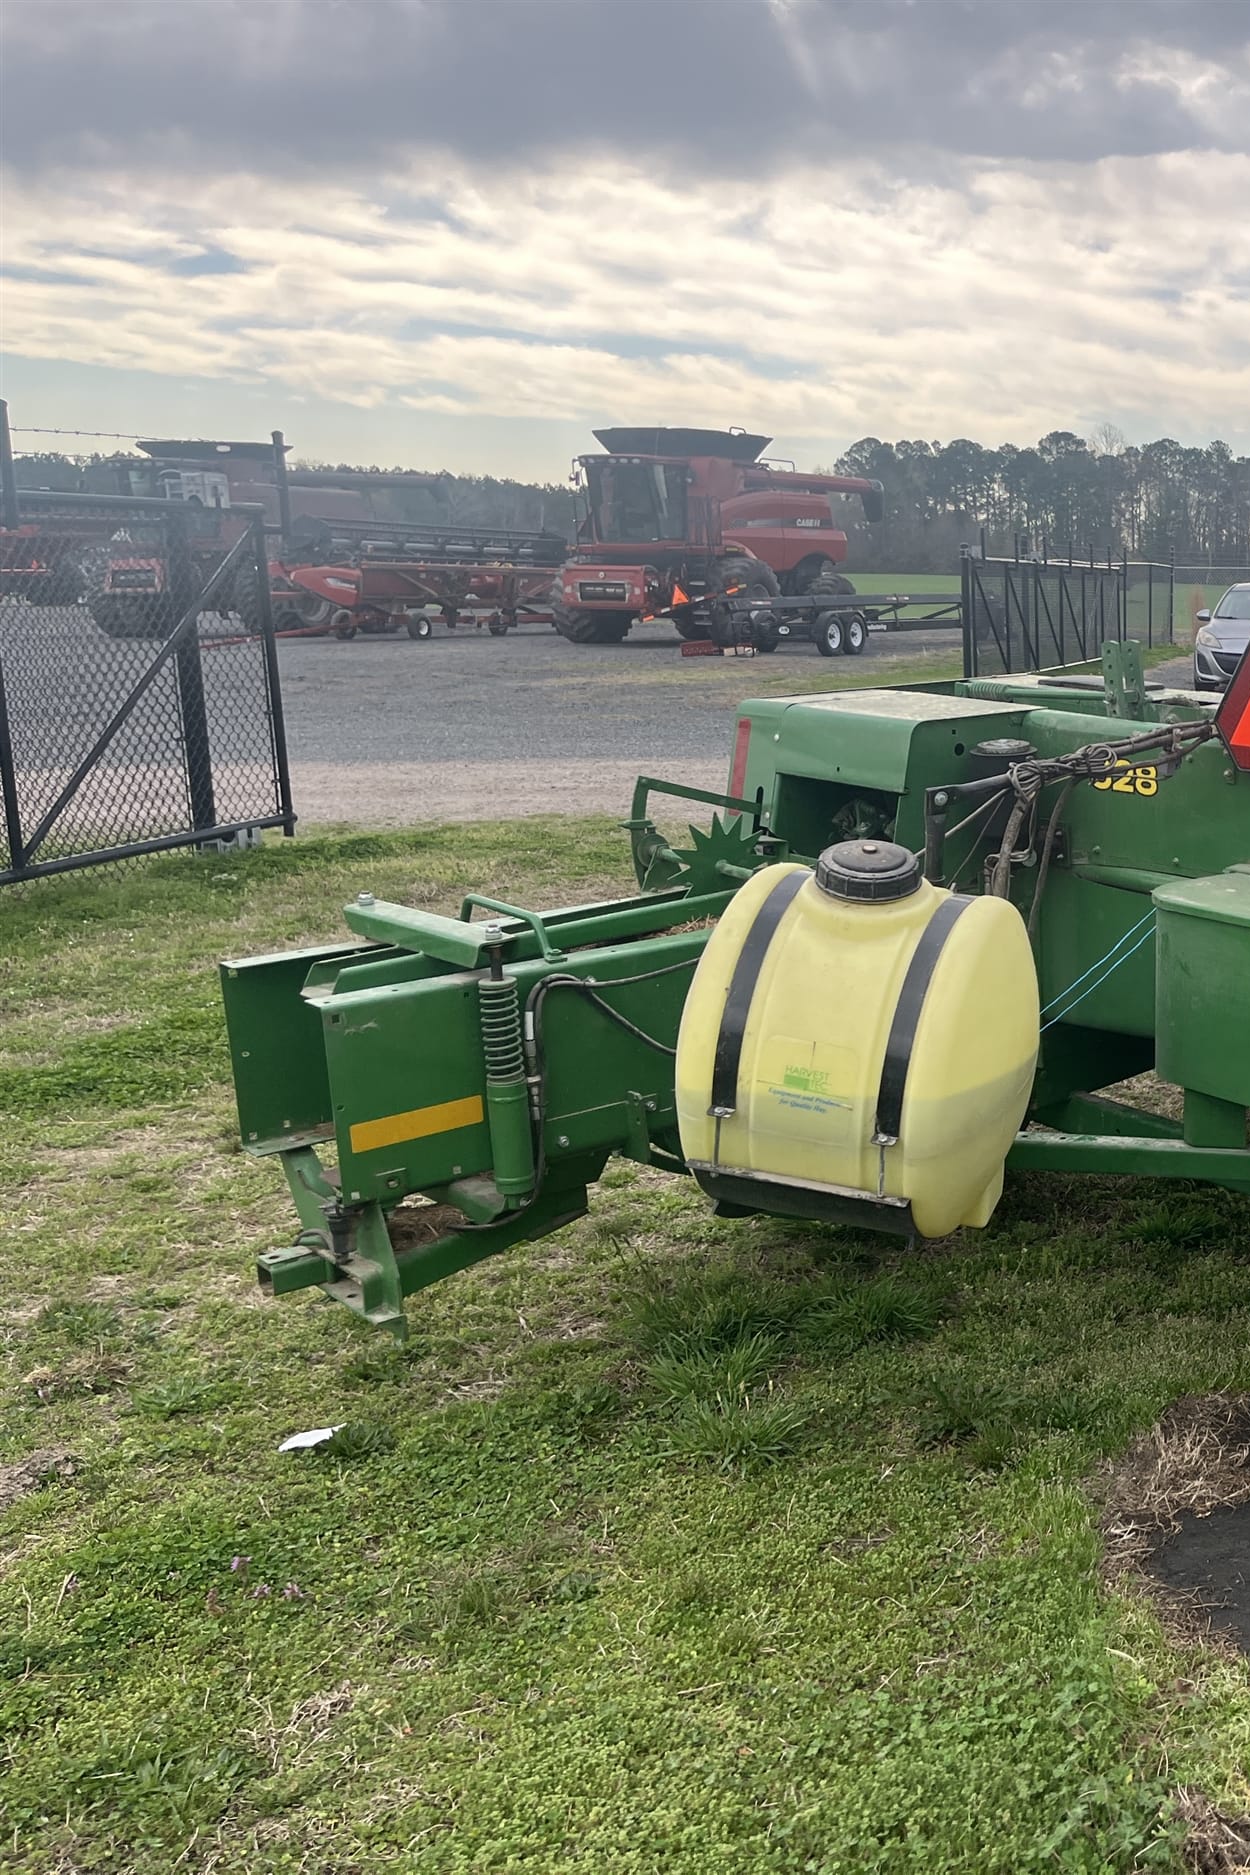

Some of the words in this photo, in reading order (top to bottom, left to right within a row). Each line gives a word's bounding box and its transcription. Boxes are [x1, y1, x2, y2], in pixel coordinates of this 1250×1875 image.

[796, 518, 813, 527] CASE
[785, 1065, 829, 1080] HARVEST
[809, 1079, 829, 1091] TEC
